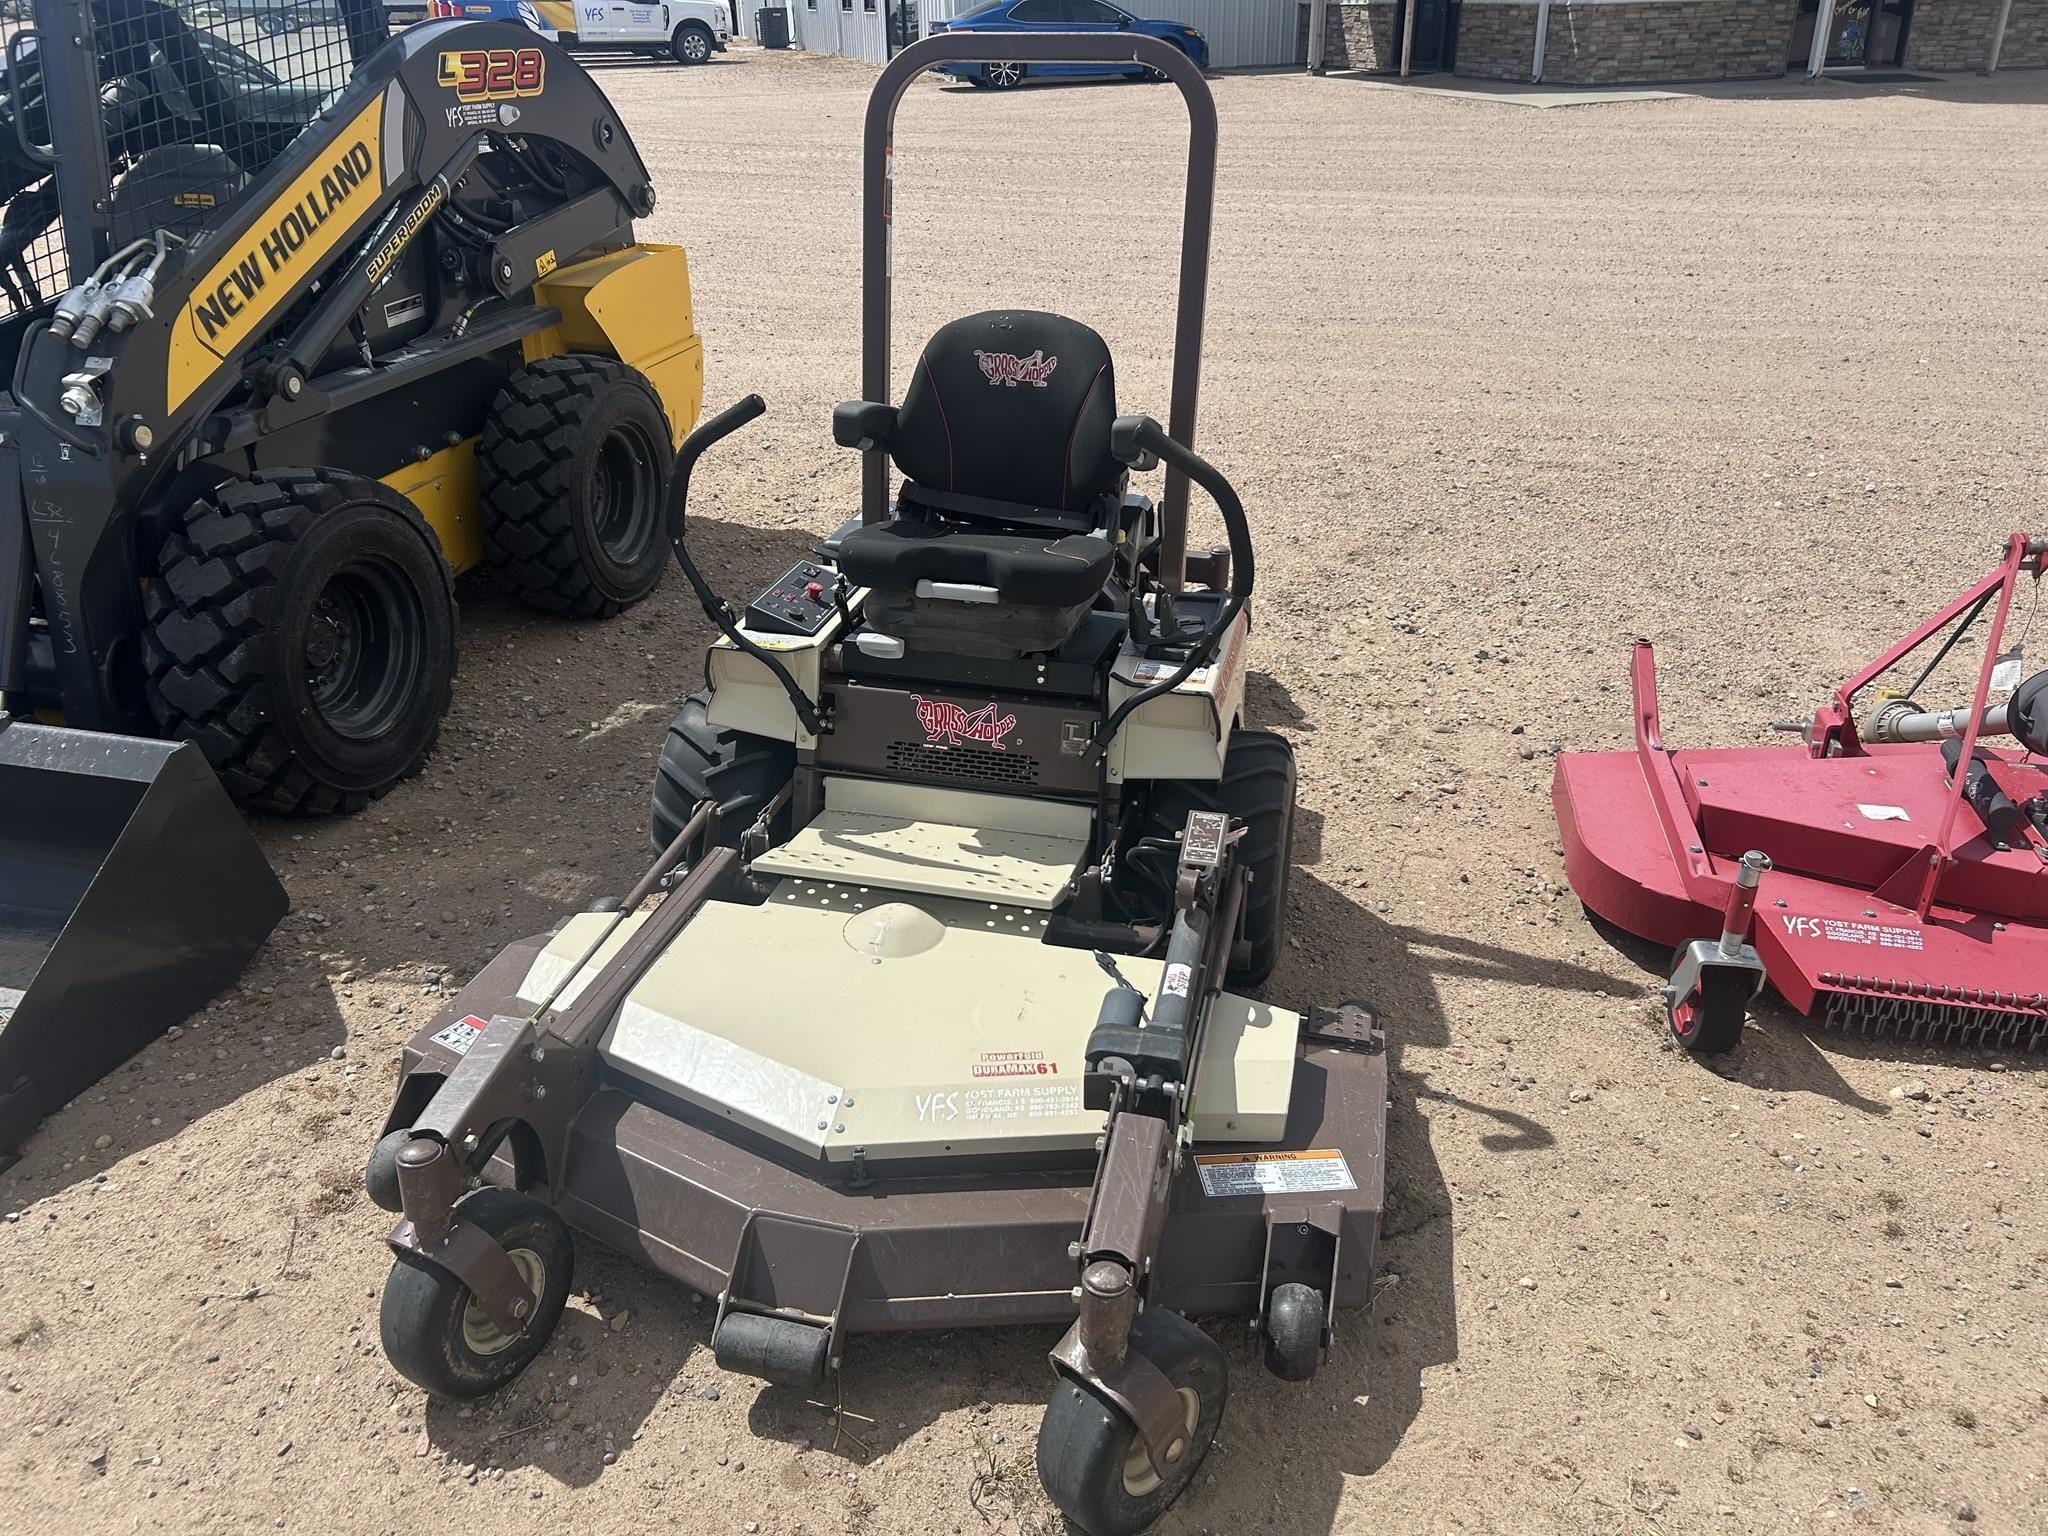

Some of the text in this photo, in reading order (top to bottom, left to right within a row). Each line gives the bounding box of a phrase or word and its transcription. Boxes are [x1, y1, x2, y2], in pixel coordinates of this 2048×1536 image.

[445, 106, 464, 128] YFS
[195, 141, 372, 340] NEW HOLLAND
[366, 226, 410, 283] SUPER
[405, 184, 441, 234] BOOM
[917, 700, 1017, 742] GRASSHOPPER
[1782, 915, 1822, 938] YFS
[1822, 918, 1921, 937] YOST FARM SUPPLY
[1037, 1062, 1058, 1075] 61
[965, 1085, 1078, 1100] YOST FARM SUPPLY
[915, 1091, 960, 1123] YFS
[1254, 1153, 1297, 1162] WARNING
